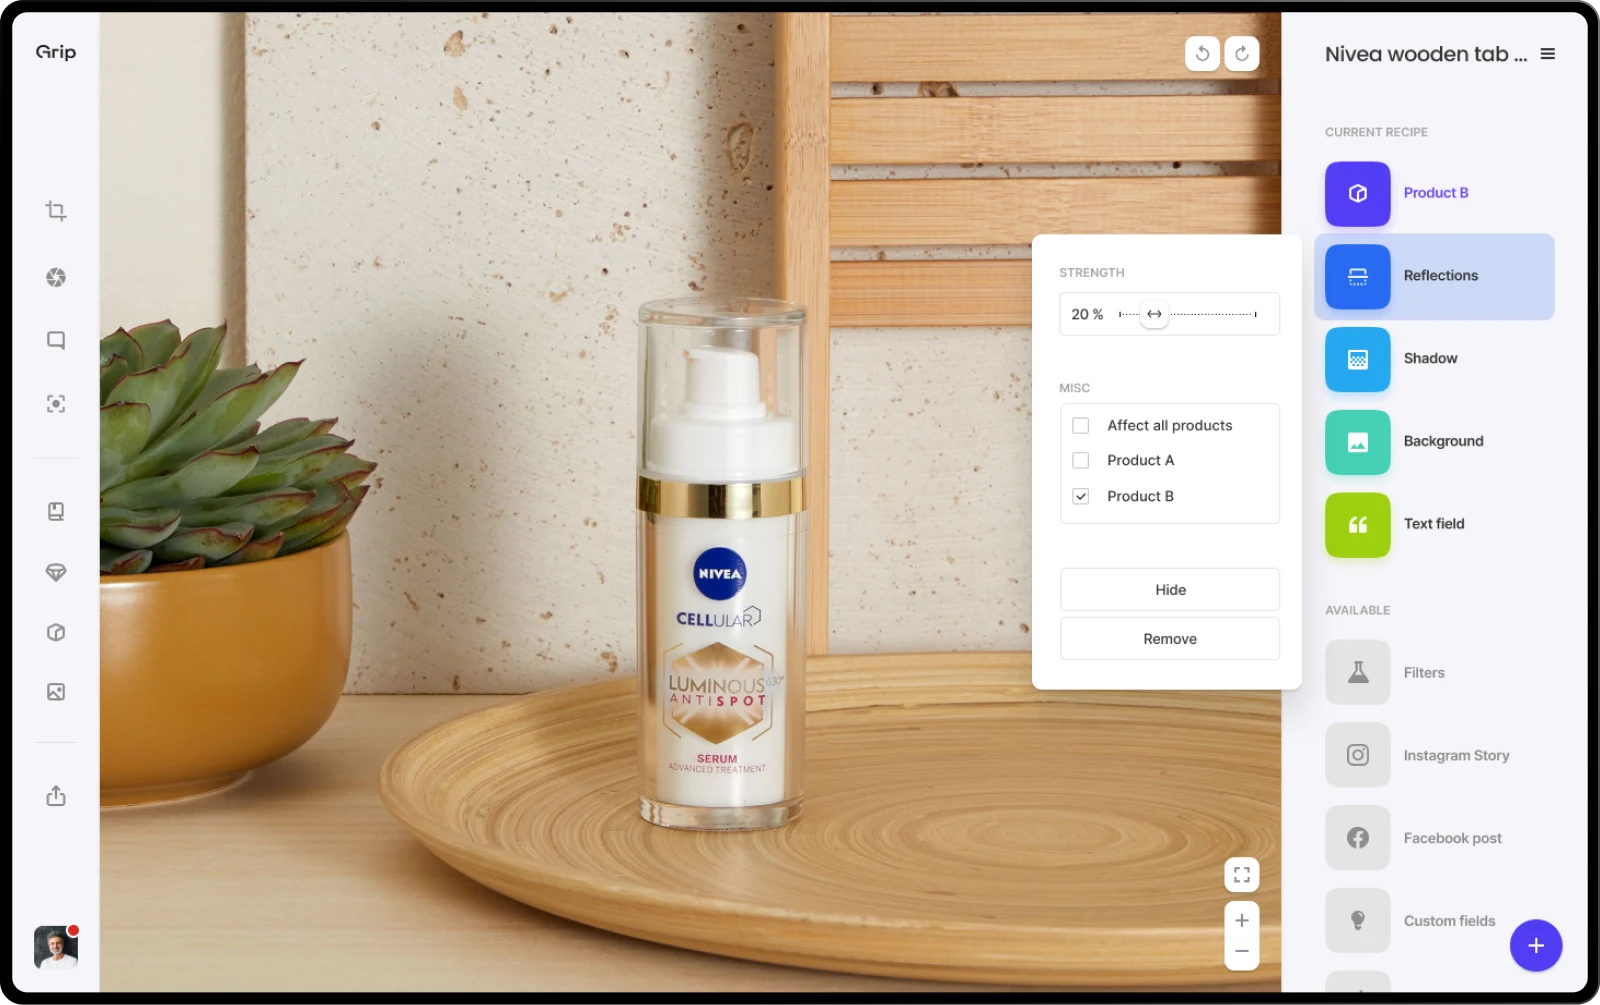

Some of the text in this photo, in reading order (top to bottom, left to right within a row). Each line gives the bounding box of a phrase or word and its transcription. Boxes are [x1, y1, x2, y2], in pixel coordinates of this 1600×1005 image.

[36, 45, 76, 62] Grip
[1326, 45, 1382, 62] Nivea
[1387, 46, 1469, 62] wooden
[1474, 46, 1509, 62] tab
[1325, 127, 1428, 137] CURRENT RECIPE
[1404, 186, 1469, 199] Product B
[1059, 267, 1125, 278] STRENGTH
[1404, 268, 1479, 282] Reflections
[1071, 307, 1104, 321] 20 %
[1403, 351, 1458, 365] Shadow
[1059, 383, 1090, 393] MISC
[1107, 418, 1233, 435] Affect all products
[1404, 434, 1485, 450] Background
[1107, 453, 1175, 467] Product A
[1107, 489, 1174, 503] Product B
[1404, 516, 1465, 530] Text field
[698, 568, 742, 580] NIVEA
[1155, 583, 1187, 596] Hide
[1325, 605, 1391, 616] AVAILABLE
[676, 611, 753, 627] CELLULAR
[1143, 632, 1198, 645] Remove
[1404, 666, 1445, 679] Filters
[669, 674, 765, 695] LUMINOUS
[697, 753, 738, 764] SERUM
[1404, 749, 1510, 765] Instagram Story
[668, 762, 767, 774] ADVANCED TREATMENT
[1404, 831, 1503, 847] Facebook post
[1404, 914, 1496, 927] Custom fields
